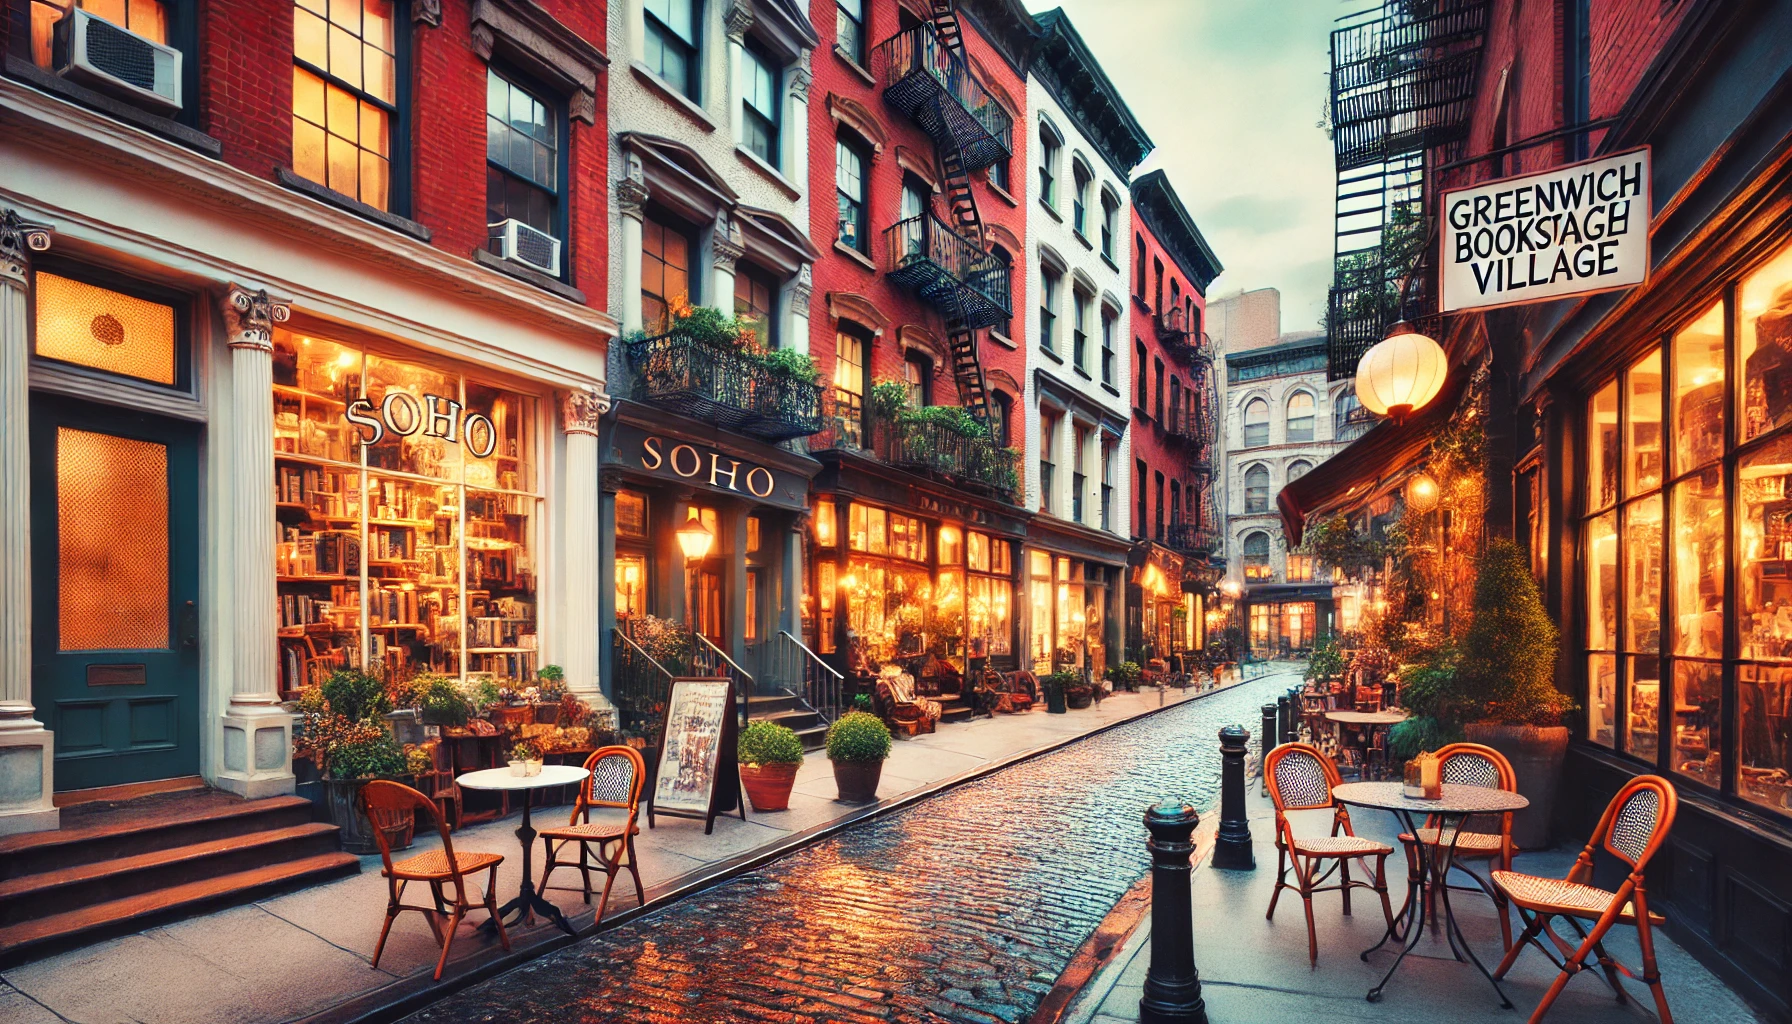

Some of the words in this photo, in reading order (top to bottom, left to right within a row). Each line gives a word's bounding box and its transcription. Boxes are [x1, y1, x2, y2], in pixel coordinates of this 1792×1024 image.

[1449, 162, 1642, 230] GREENWICH
[1471, 240, 1619, 295] VILLAGE
[346, 392, 497, 458] SOHO
[641, 436, 774, 498] SOHO
